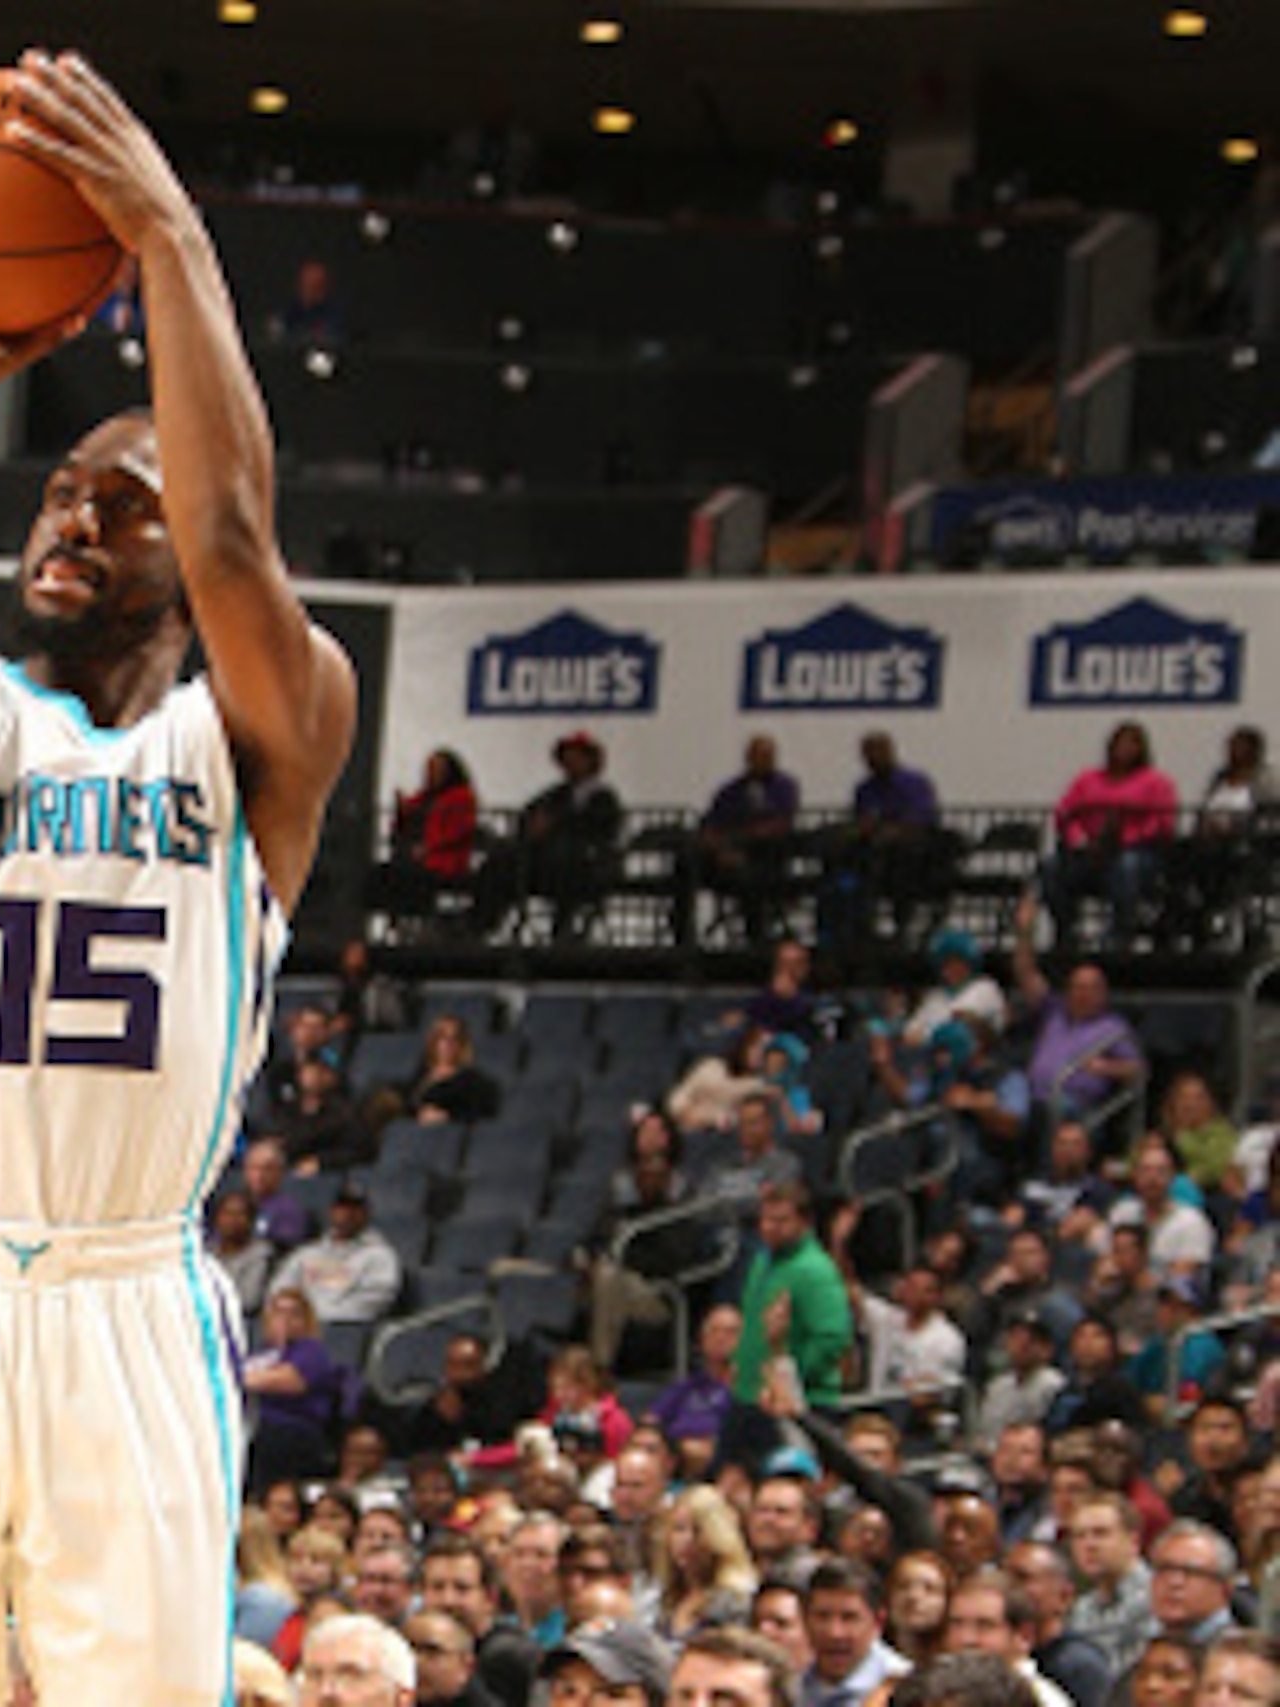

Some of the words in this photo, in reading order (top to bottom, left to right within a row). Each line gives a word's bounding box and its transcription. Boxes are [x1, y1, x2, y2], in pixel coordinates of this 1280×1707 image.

[483, 644, 645, 708] LOWE'S
[759, 641, 928, 701] LOWE'S
[1049, 634, 1226, 697] LOWE'S
